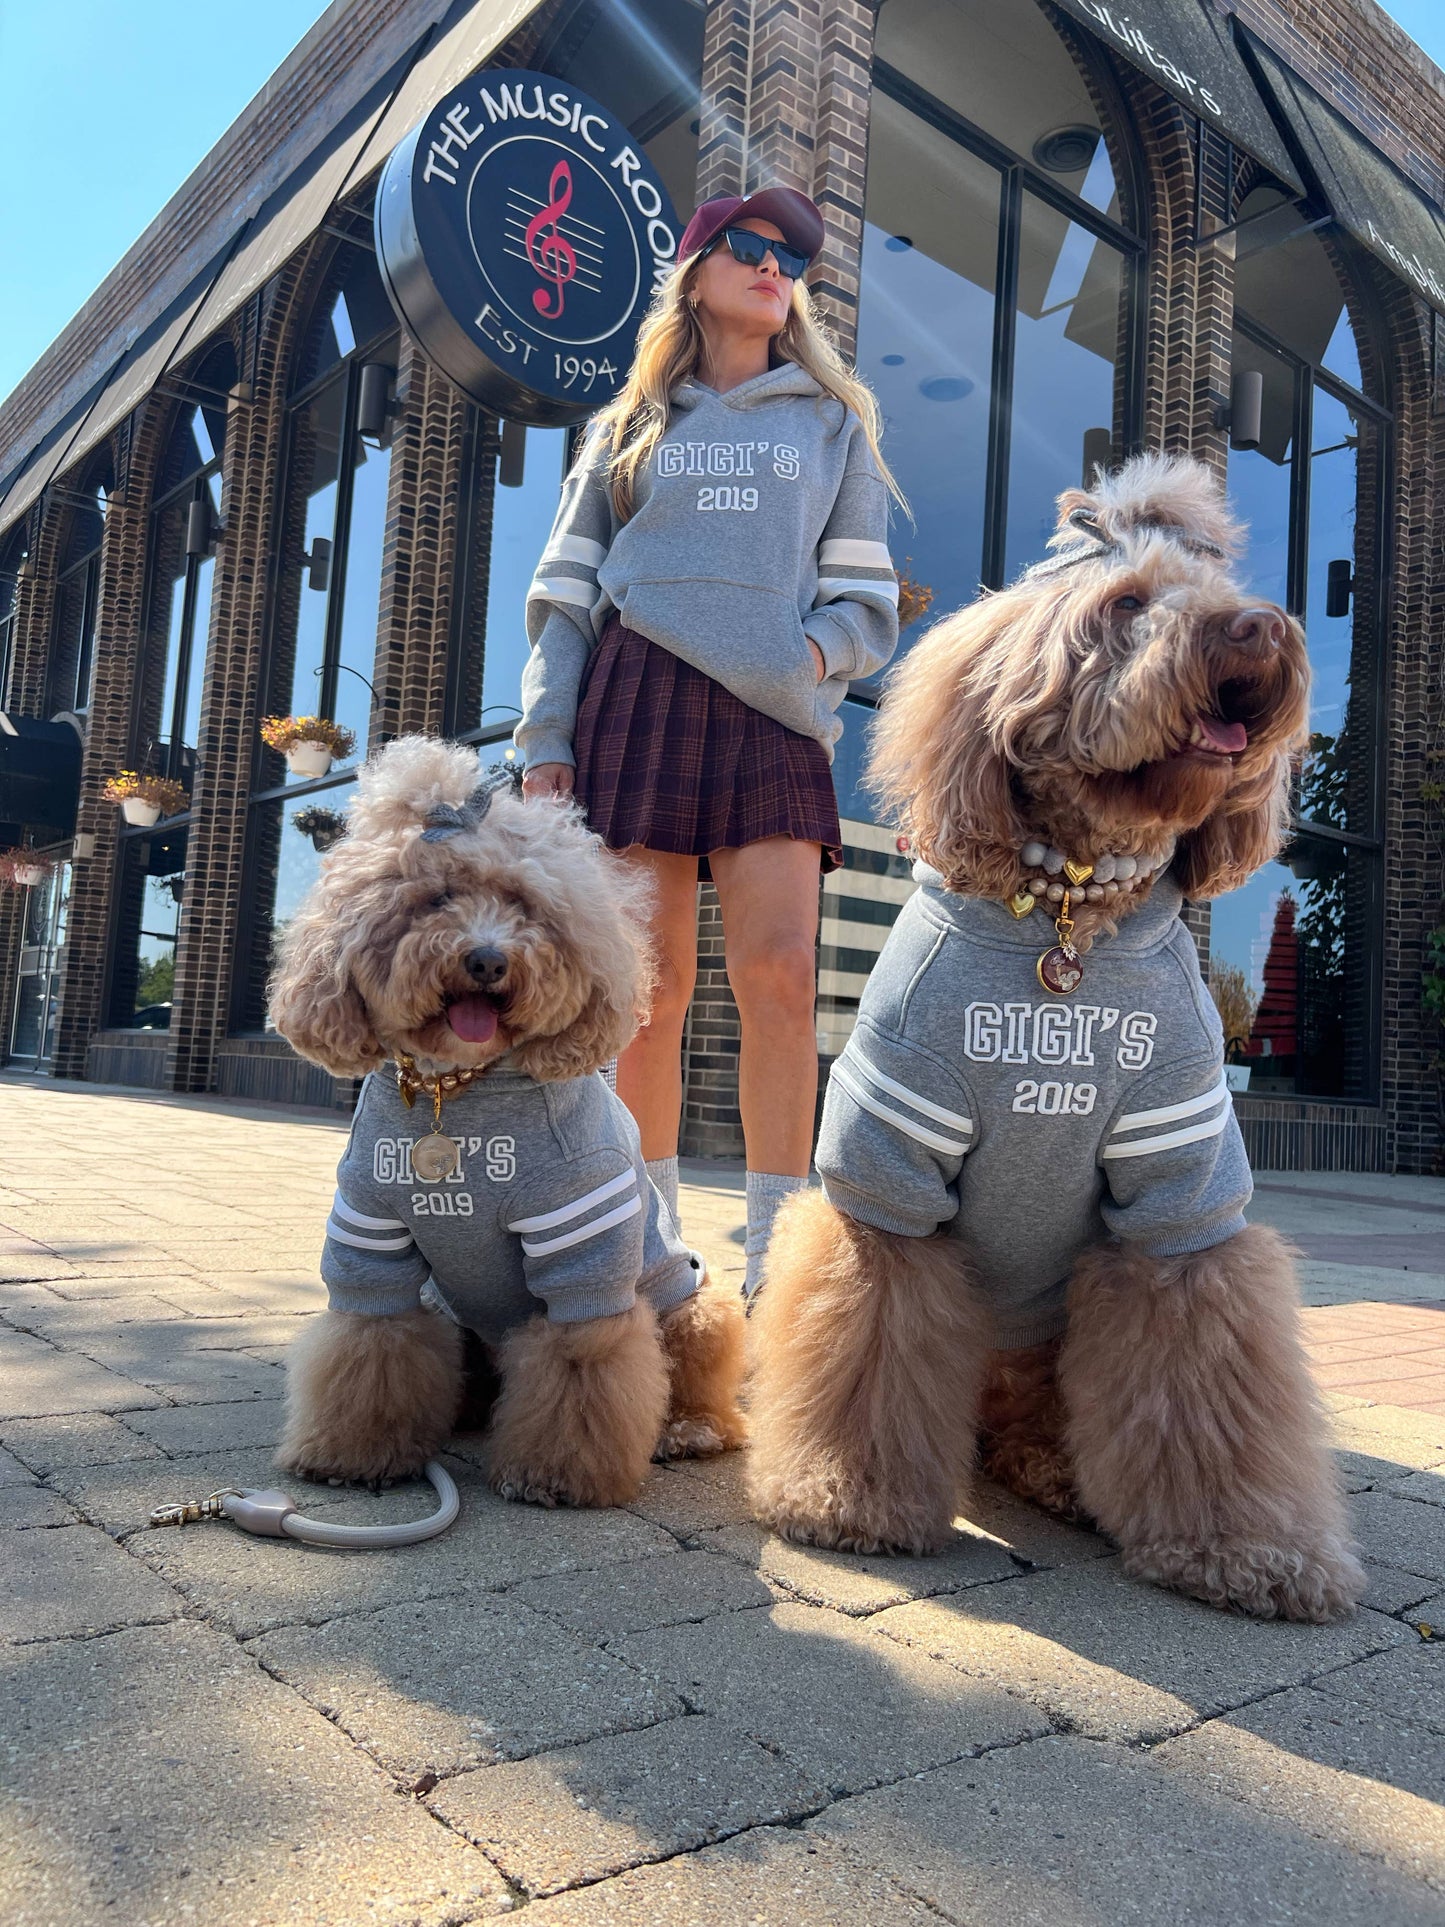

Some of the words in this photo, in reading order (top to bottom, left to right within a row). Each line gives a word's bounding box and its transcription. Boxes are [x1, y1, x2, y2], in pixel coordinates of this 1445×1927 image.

[423, 102, 485, 185] THE
[479, 82, 609, 152] MUSIC
[474, 303, 539, 364] EST
[553, 352, 618, 392] 1994
[657, 441, 800, 481] GIGI'S
[696, 486, 759, 512] 2019
[963, 1001, 1158, 1071] GIGI'S
[1012, 1079, 1098, 1116] 2019
[373, 1135, 516, 1185] GII'S
[411, 1192, 474, 1217] 2019
